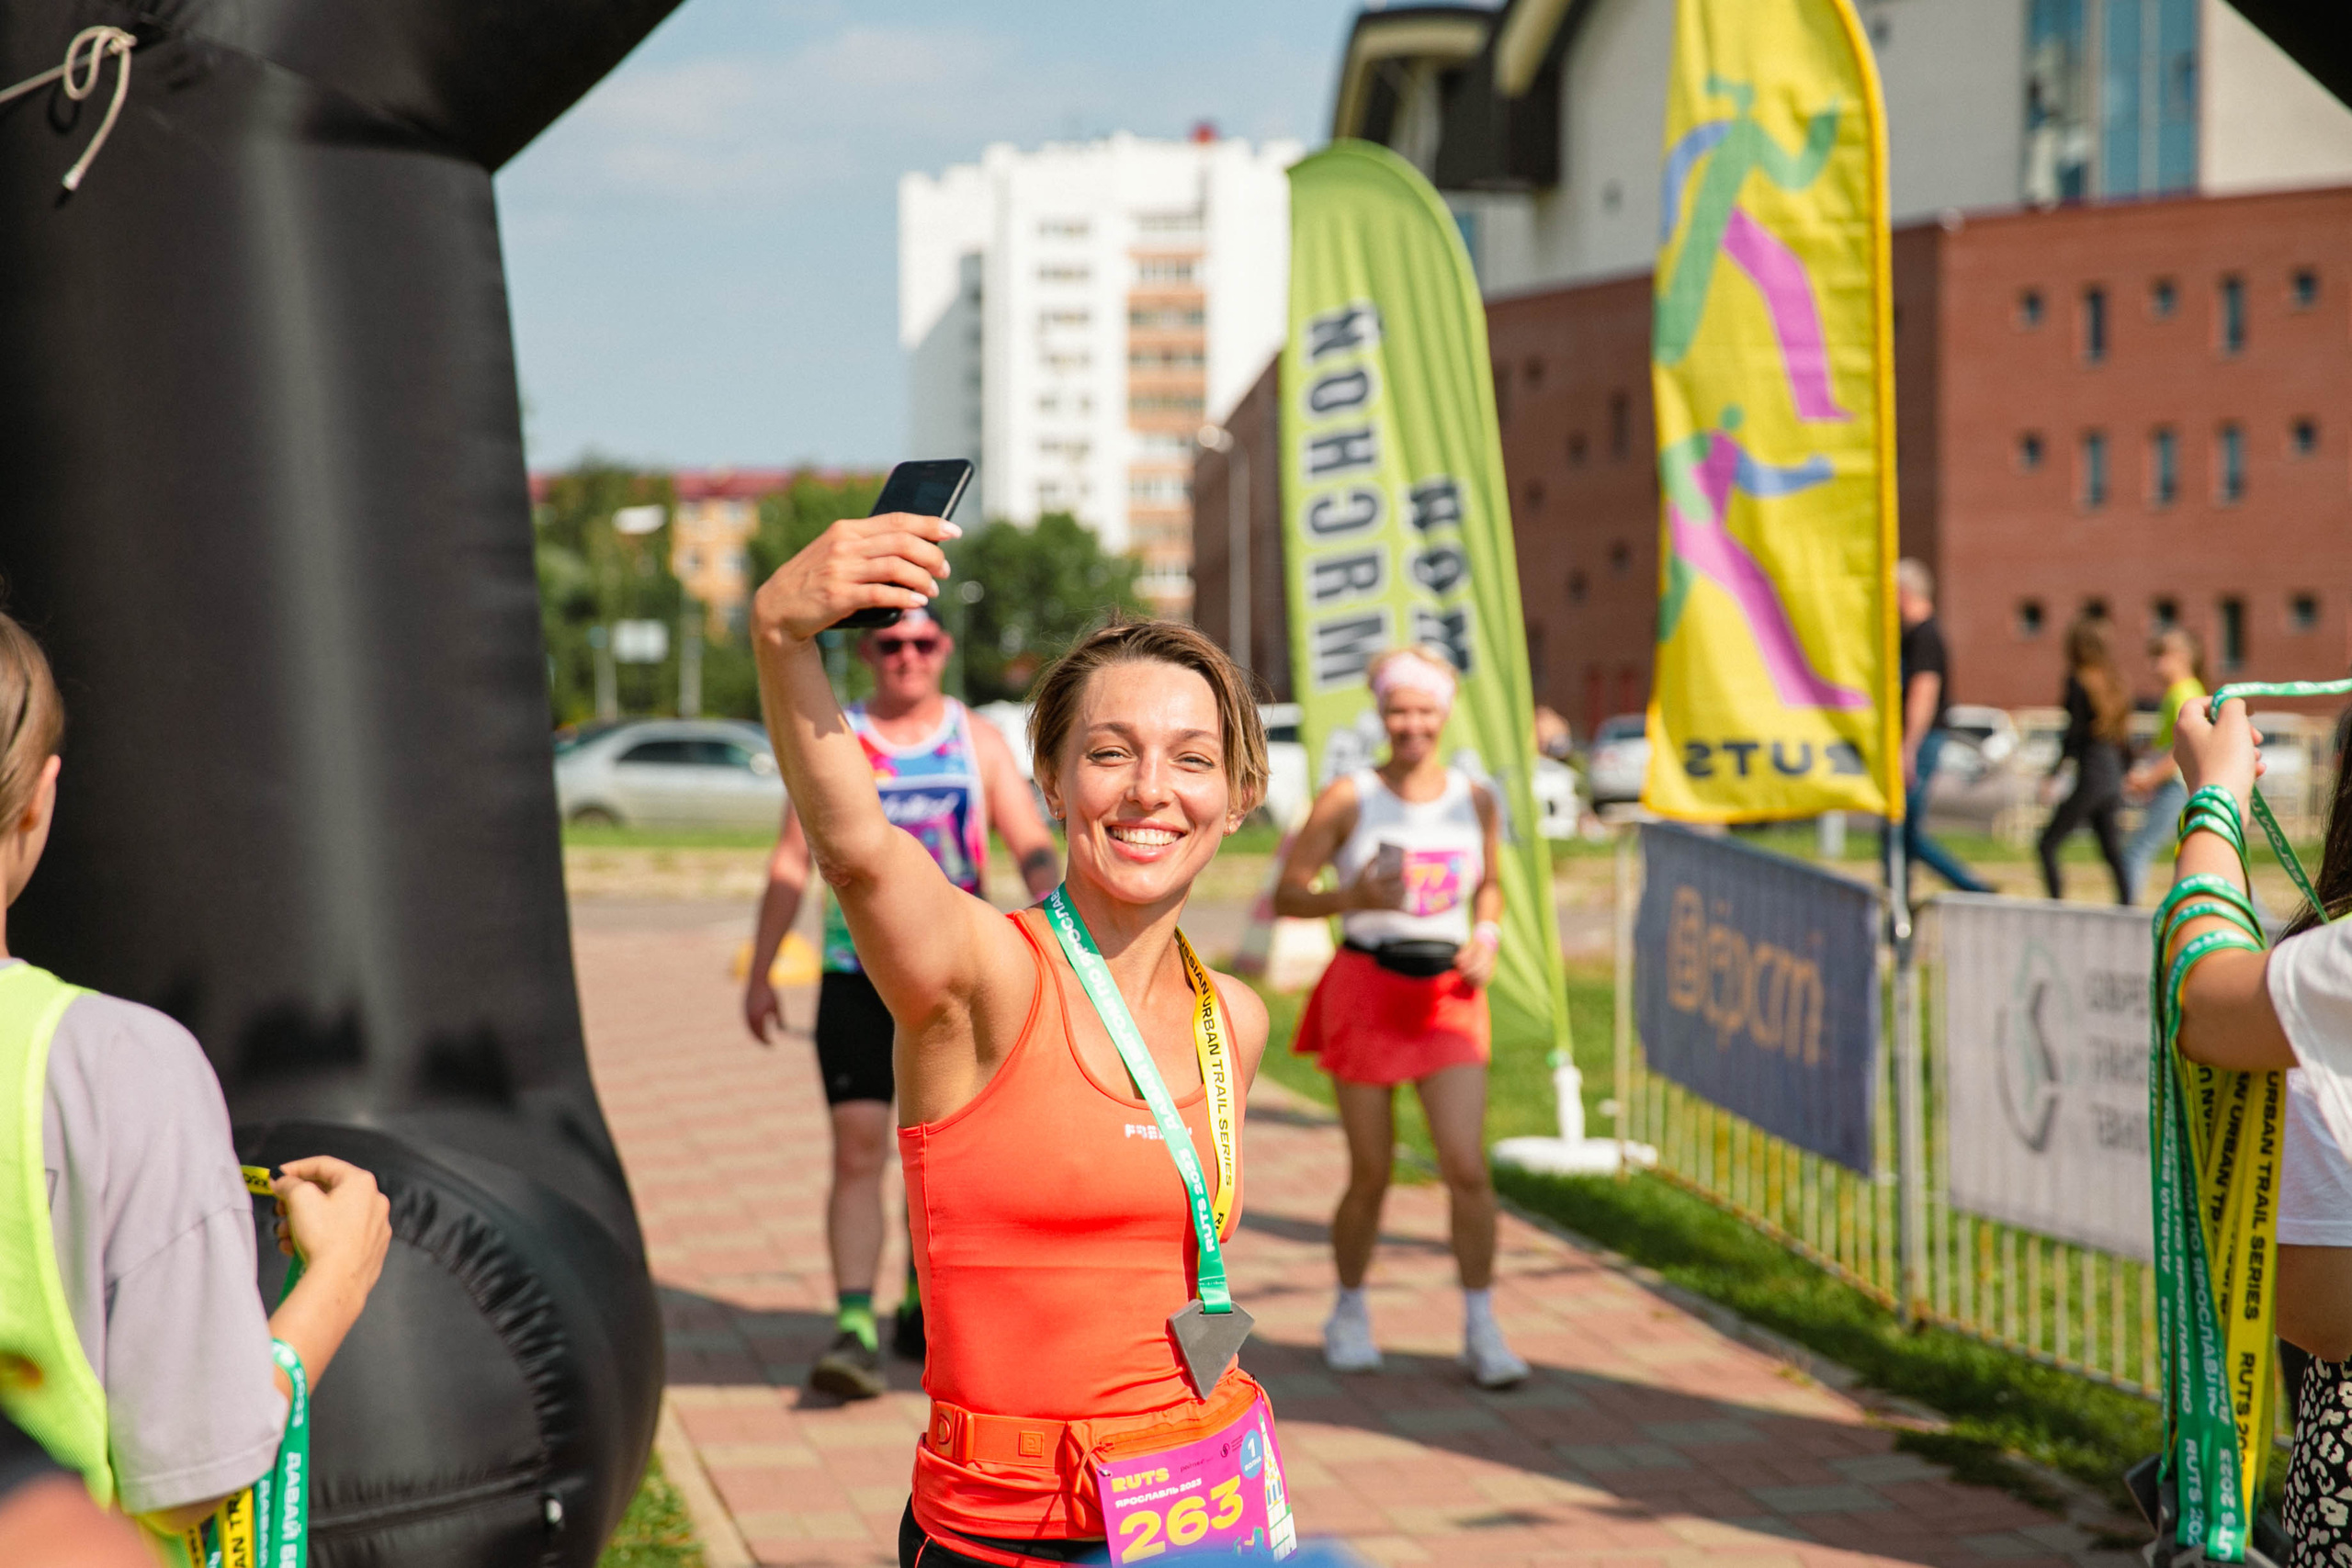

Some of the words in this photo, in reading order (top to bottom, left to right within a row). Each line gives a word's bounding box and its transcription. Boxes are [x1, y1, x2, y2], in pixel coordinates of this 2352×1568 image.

[1050, 887, 1096, 967] ЯРОСЛАВ
[1088, 967, 1111, 997] ПО
[1202, 995, 1222, 1056] URBAN
[1211, 1062, 1232, 1114] TRAIL
[2260, 1070, 2281, 1156] URBAN
[1125, 1123, 1193, 1140] FRE
[1217, 1117, 1233, 1187] SERIES
[2214, 1104, 2244, 1186] URBAN
[1178, 1147, 1204, 1196] 2023
[2251, 1162, 2273, 1230] TRAIL
[1196, 1198, 1216, 1253] RUTS
[2243, 1234, 2267, 1321] SERIES
[2235, 1351, 2256, 1416] RUTS
[1247, 1437, 1257, 1459] 1
[2184, 1438, 2203, 1502] RUTS
[2219, 1448, 2236, 1509] 2023
[281, 1451, 302, 1541] ДАВАЙ
[1111, 1467, 1170, 1493] RUTS
[1114, 1487, 1180, 1508] ЯРОСЛАВЛЬ
[1180, 1477, 1203, 1495] 2023
[1118, 1473, 1245, 1565] 263
[2186, 1507, 2204, 1549] 202
[2217, 1512, 2236, 1561] UTS
